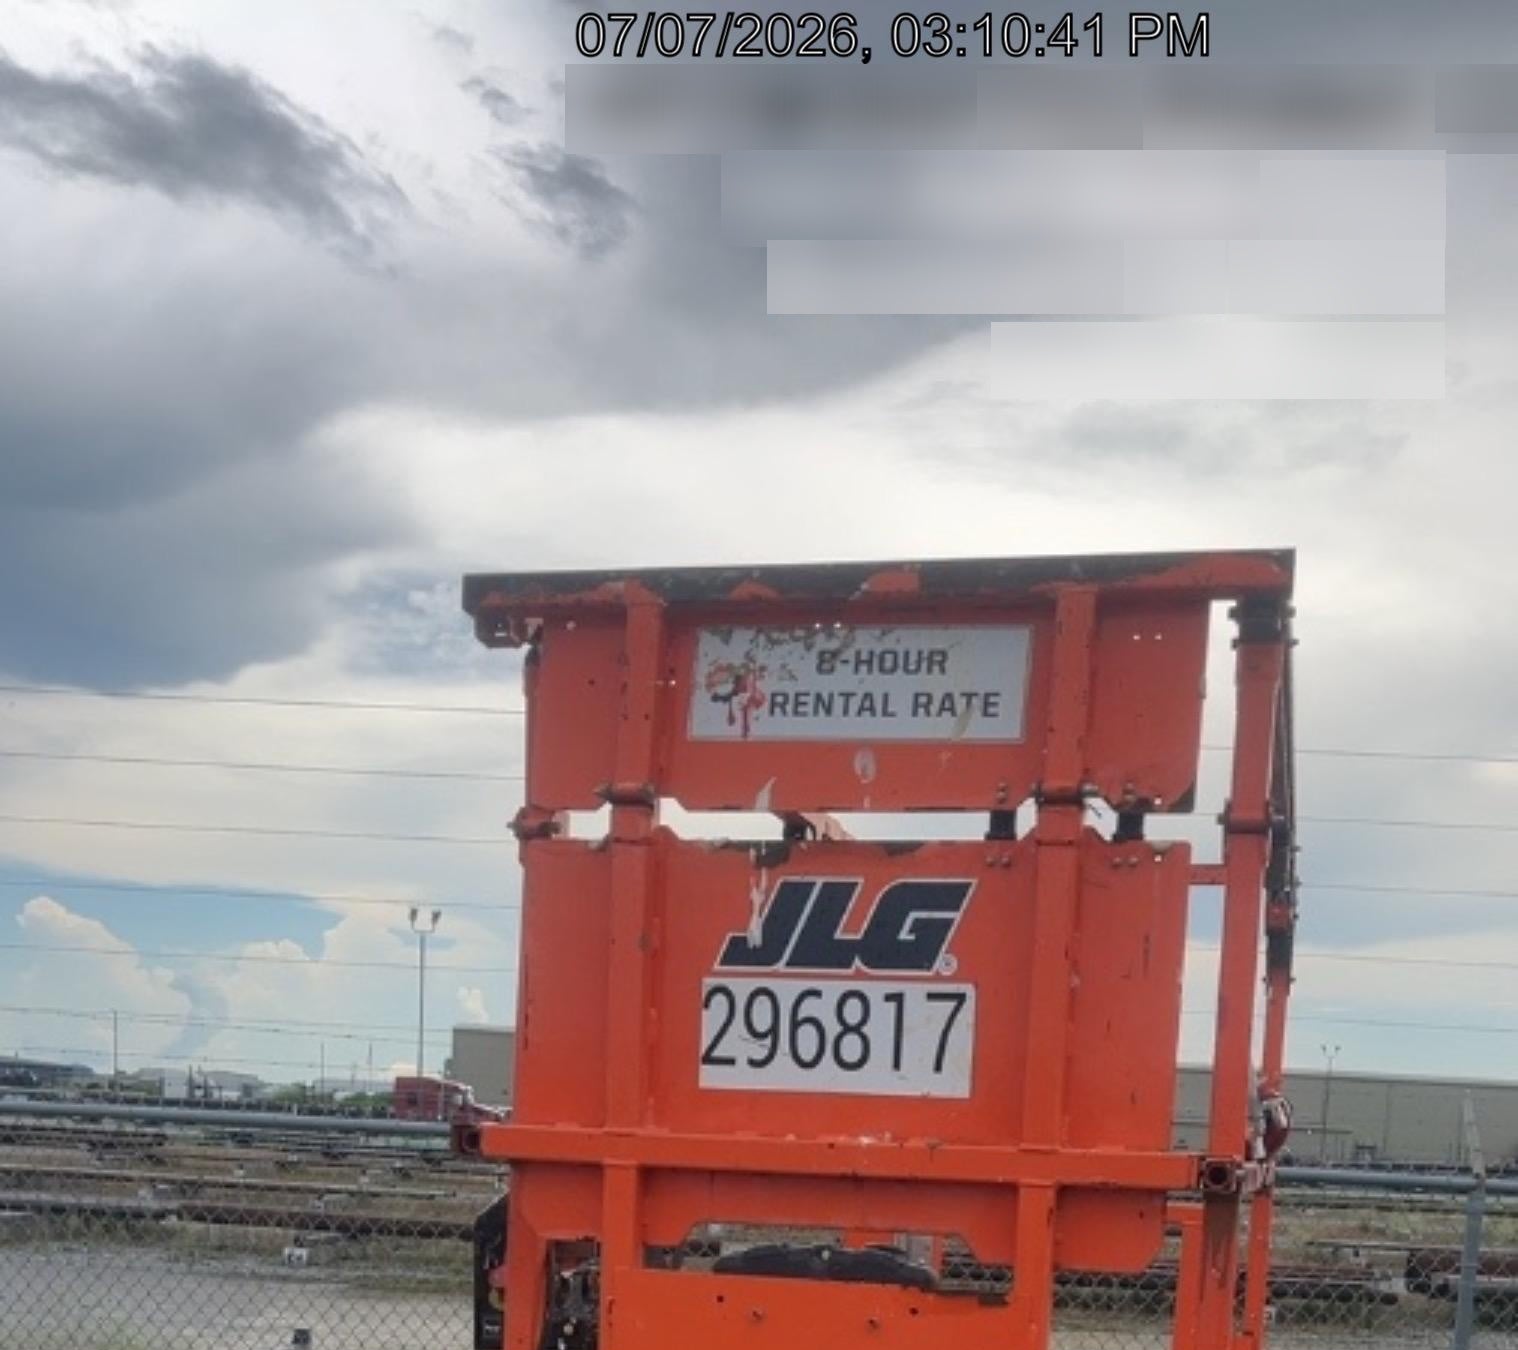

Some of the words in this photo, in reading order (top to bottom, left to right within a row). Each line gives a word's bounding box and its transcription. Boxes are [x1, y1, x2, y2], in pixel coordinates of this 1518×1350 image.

[816, 649, 948, 676] 8-HOUR
[768, 691, 896, 717] RENTAL
[911, 691, 1001, 718] RATE
[700, 984, 967, 1074] 296817
